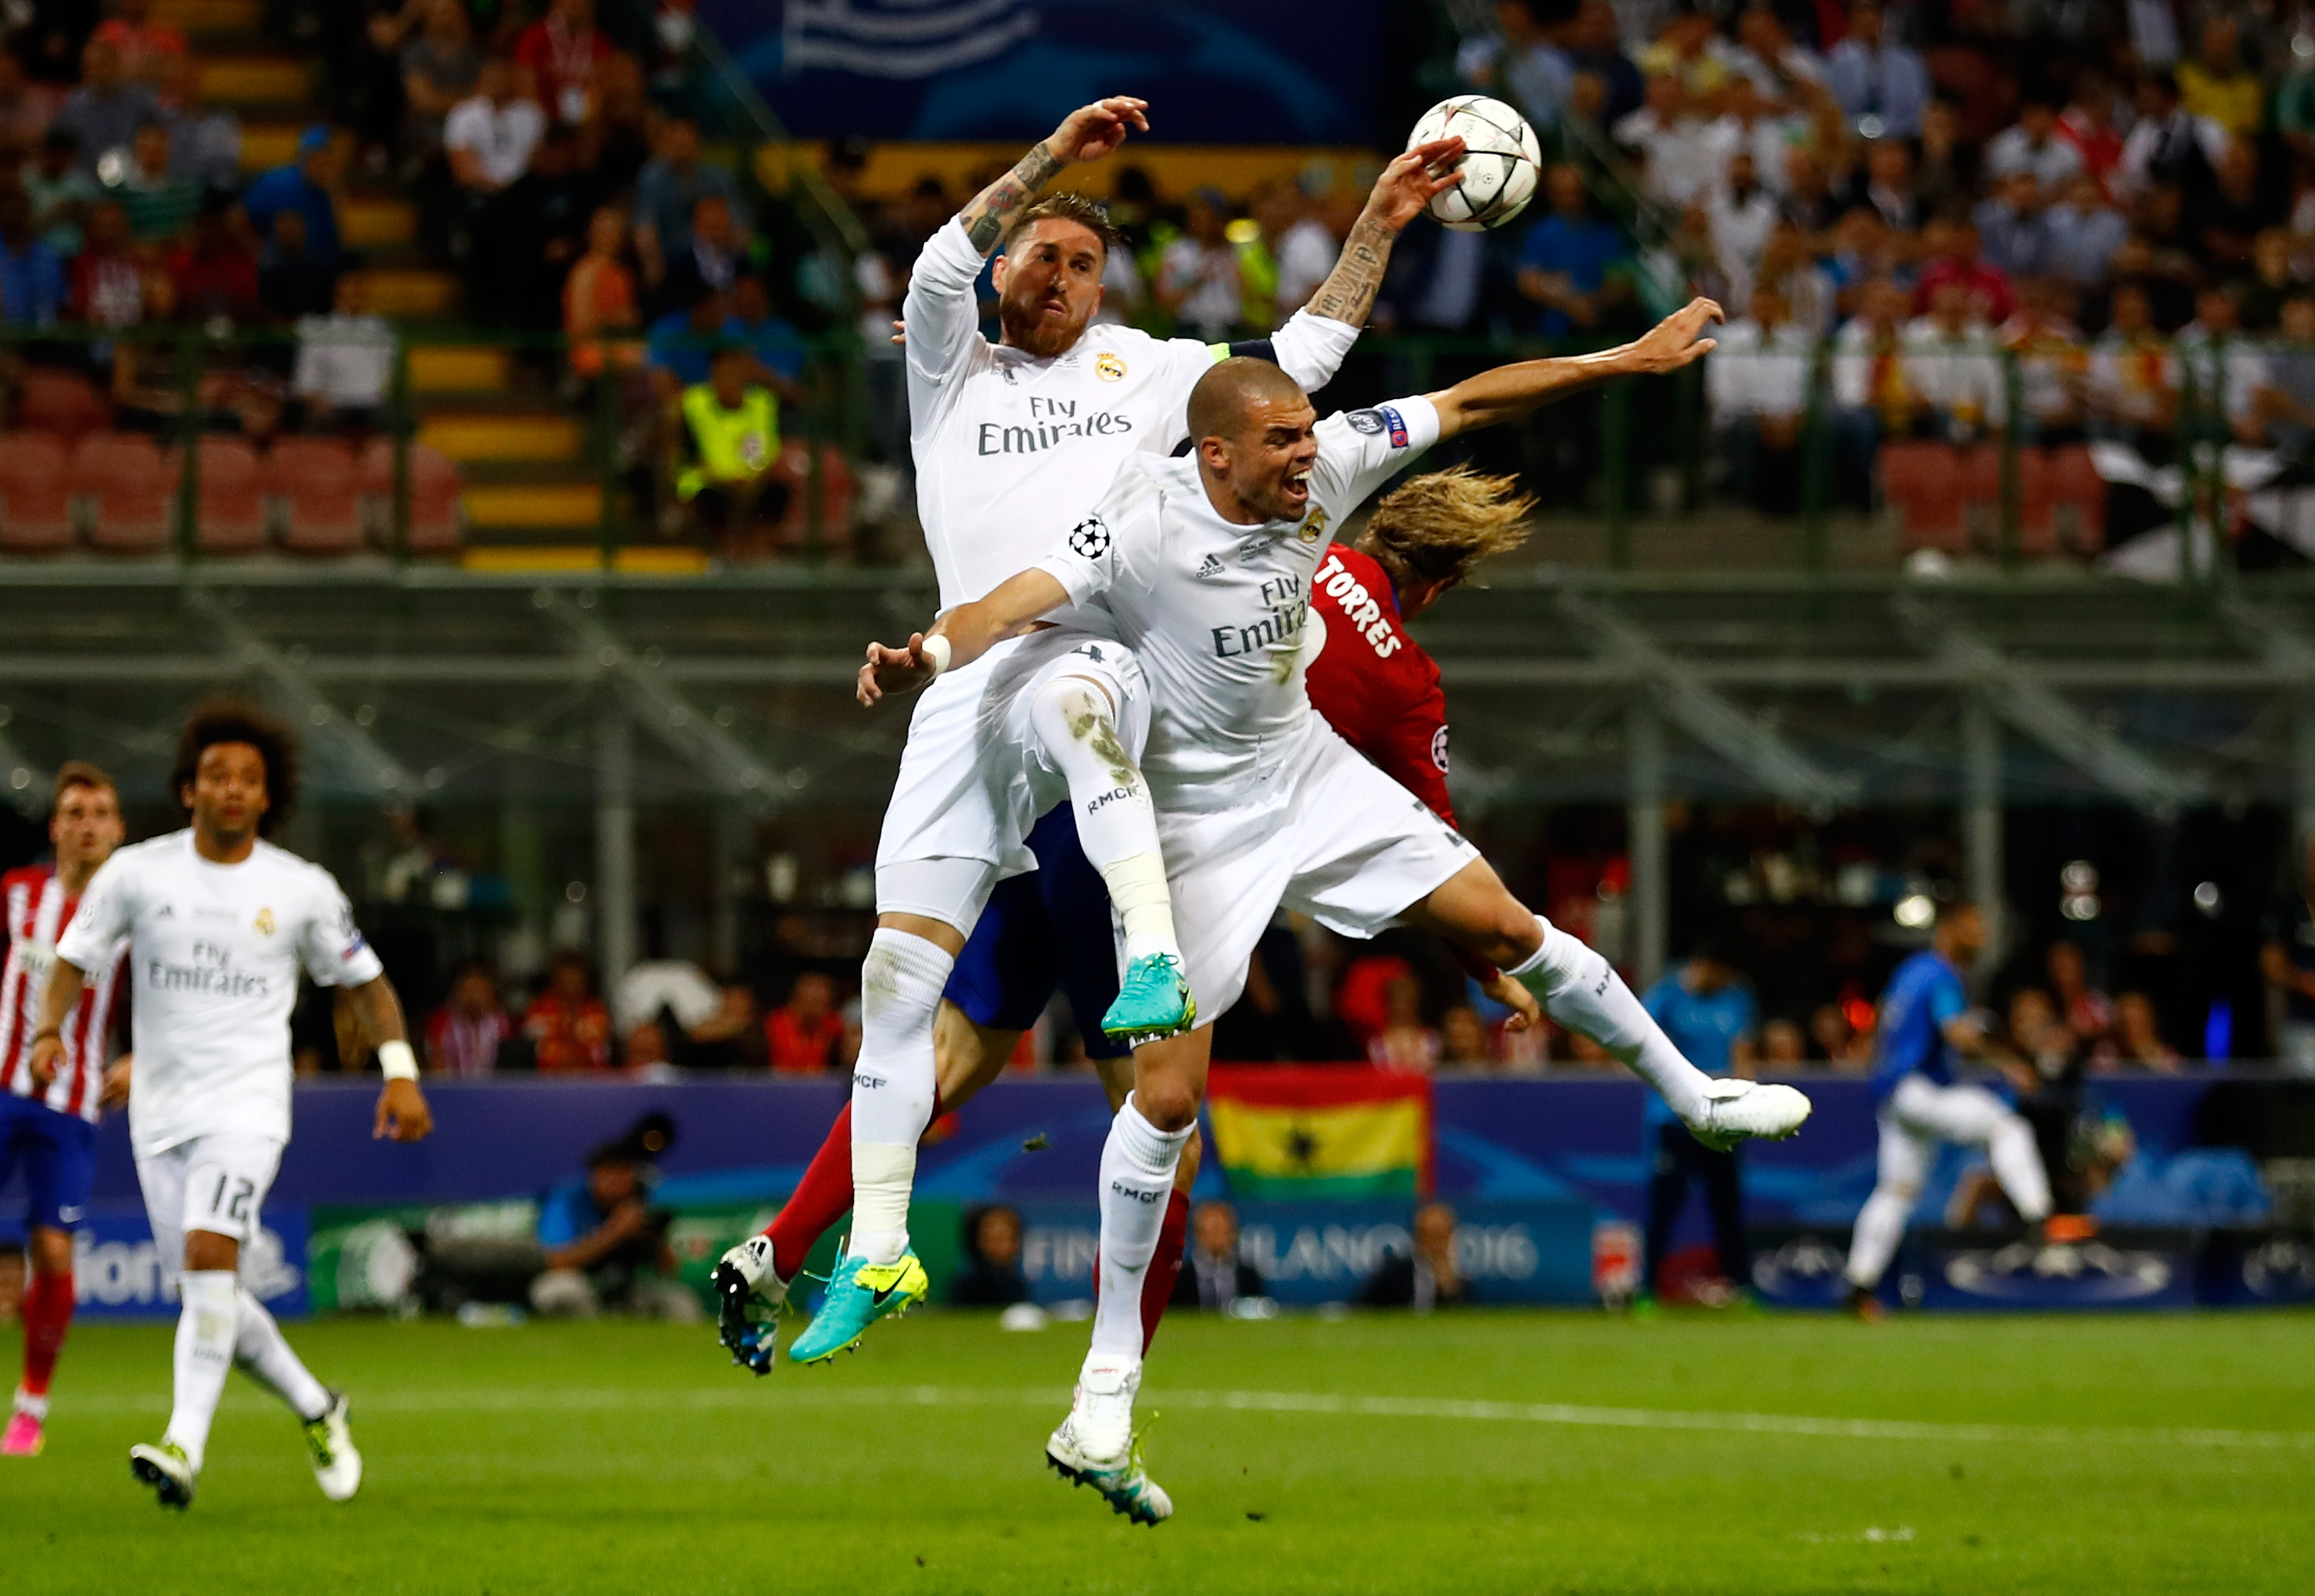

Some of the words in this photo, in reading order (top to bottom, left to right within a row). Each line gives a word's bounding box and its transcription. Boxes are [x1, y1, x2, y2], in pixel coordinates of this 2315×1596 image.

[1029, 395, 1076, 417] Fly
[978, 411, 1133, 456] Emirates
[1260, 573, 1299, 606] Fly
[1313, 554, 1402, 658] TORRES
[1210, 590, 1311, 658] Emira
[149, 961, 270, 997] Emirates
[853, 1074, 887, 1089] MCF
[211, 1171, 254, 1222] 12
